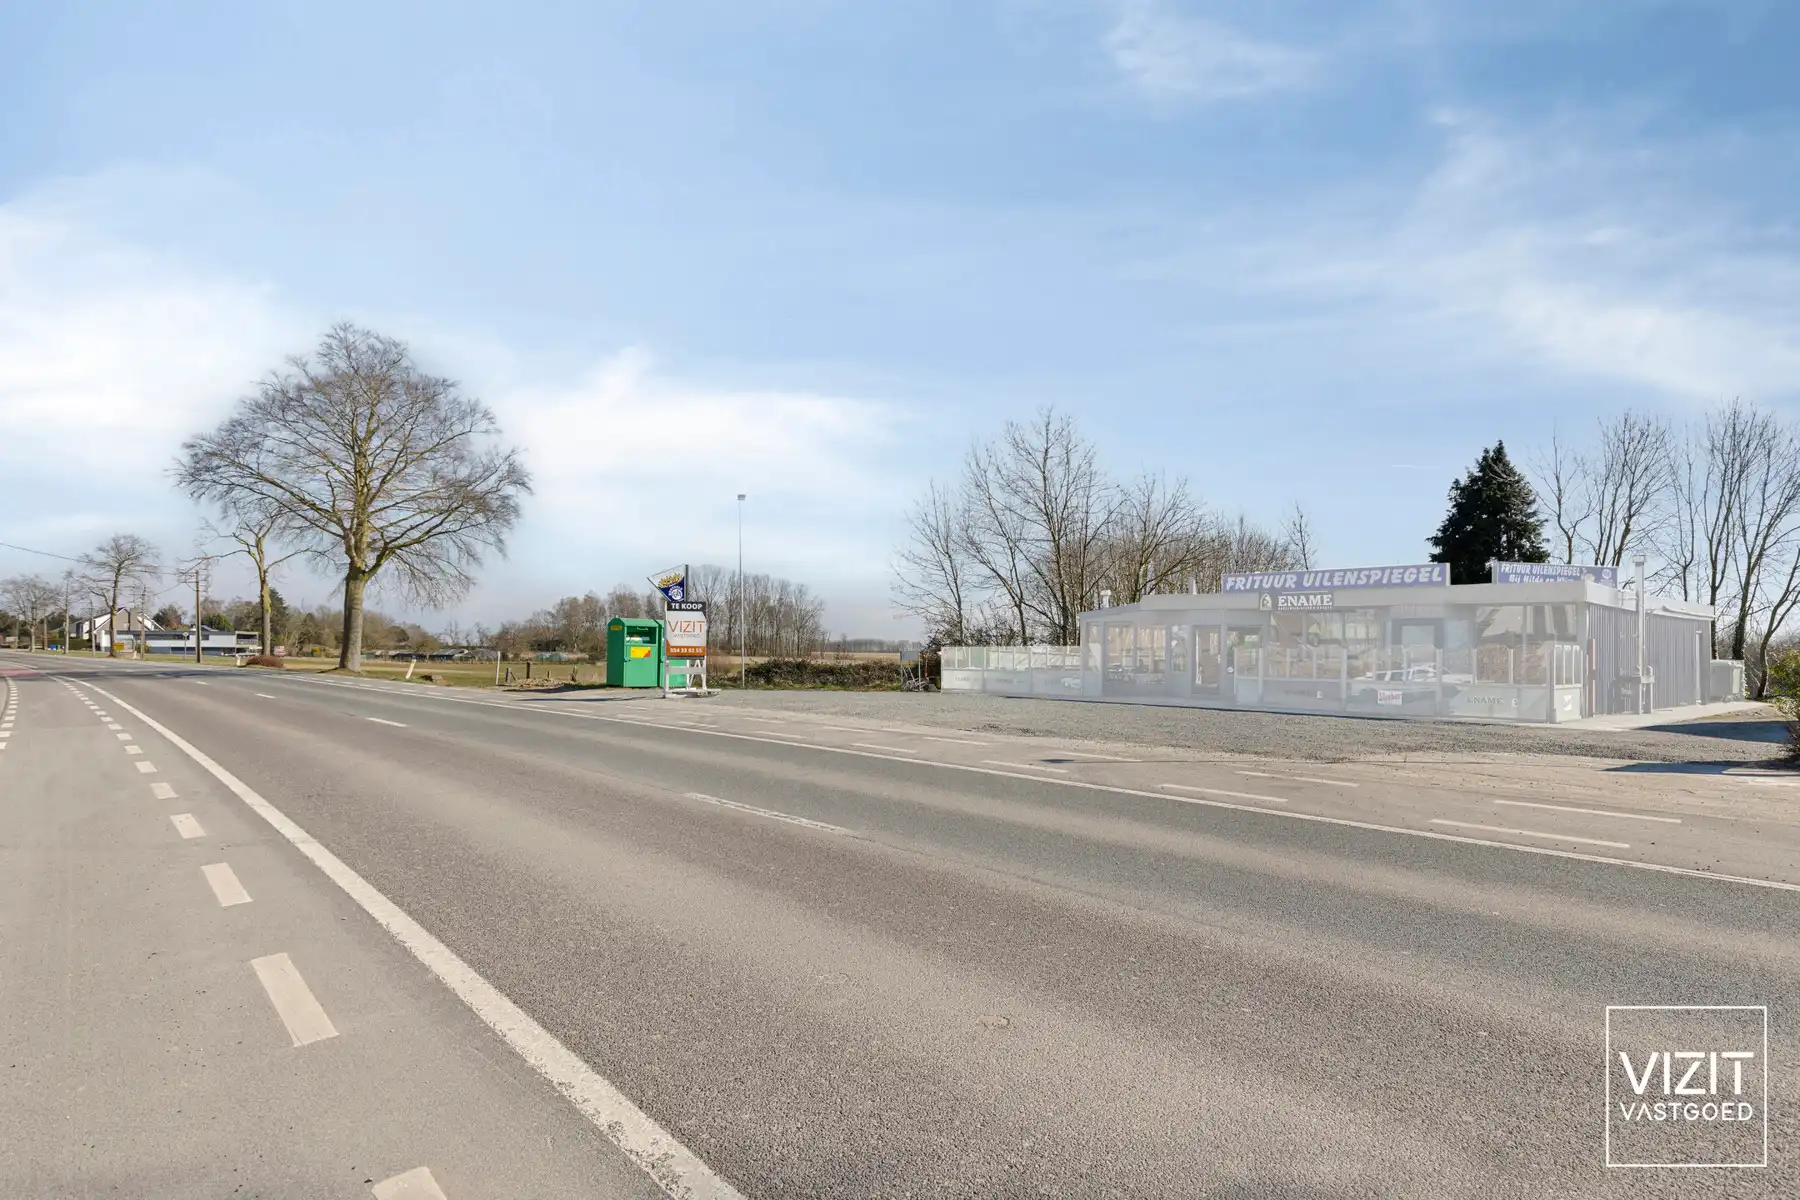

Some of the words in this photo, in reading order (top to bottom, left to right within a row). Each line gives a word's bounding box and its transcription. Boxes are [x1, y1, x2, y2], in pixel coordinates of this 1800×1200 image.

[1501, 563, 1531, 575] FRITUUR
[1532, 564, 1580, 576] UILENSPIEGEL
[1225, 573, 1296, 591] FRITUUR
[1302, 567, 1442, 587] UILENSPIEGEL
[1277, 593, 1333, 607] ENAME
[668, 621, 705, 632] VIZIT
[1467, 696, 1505, 705] ENAME
